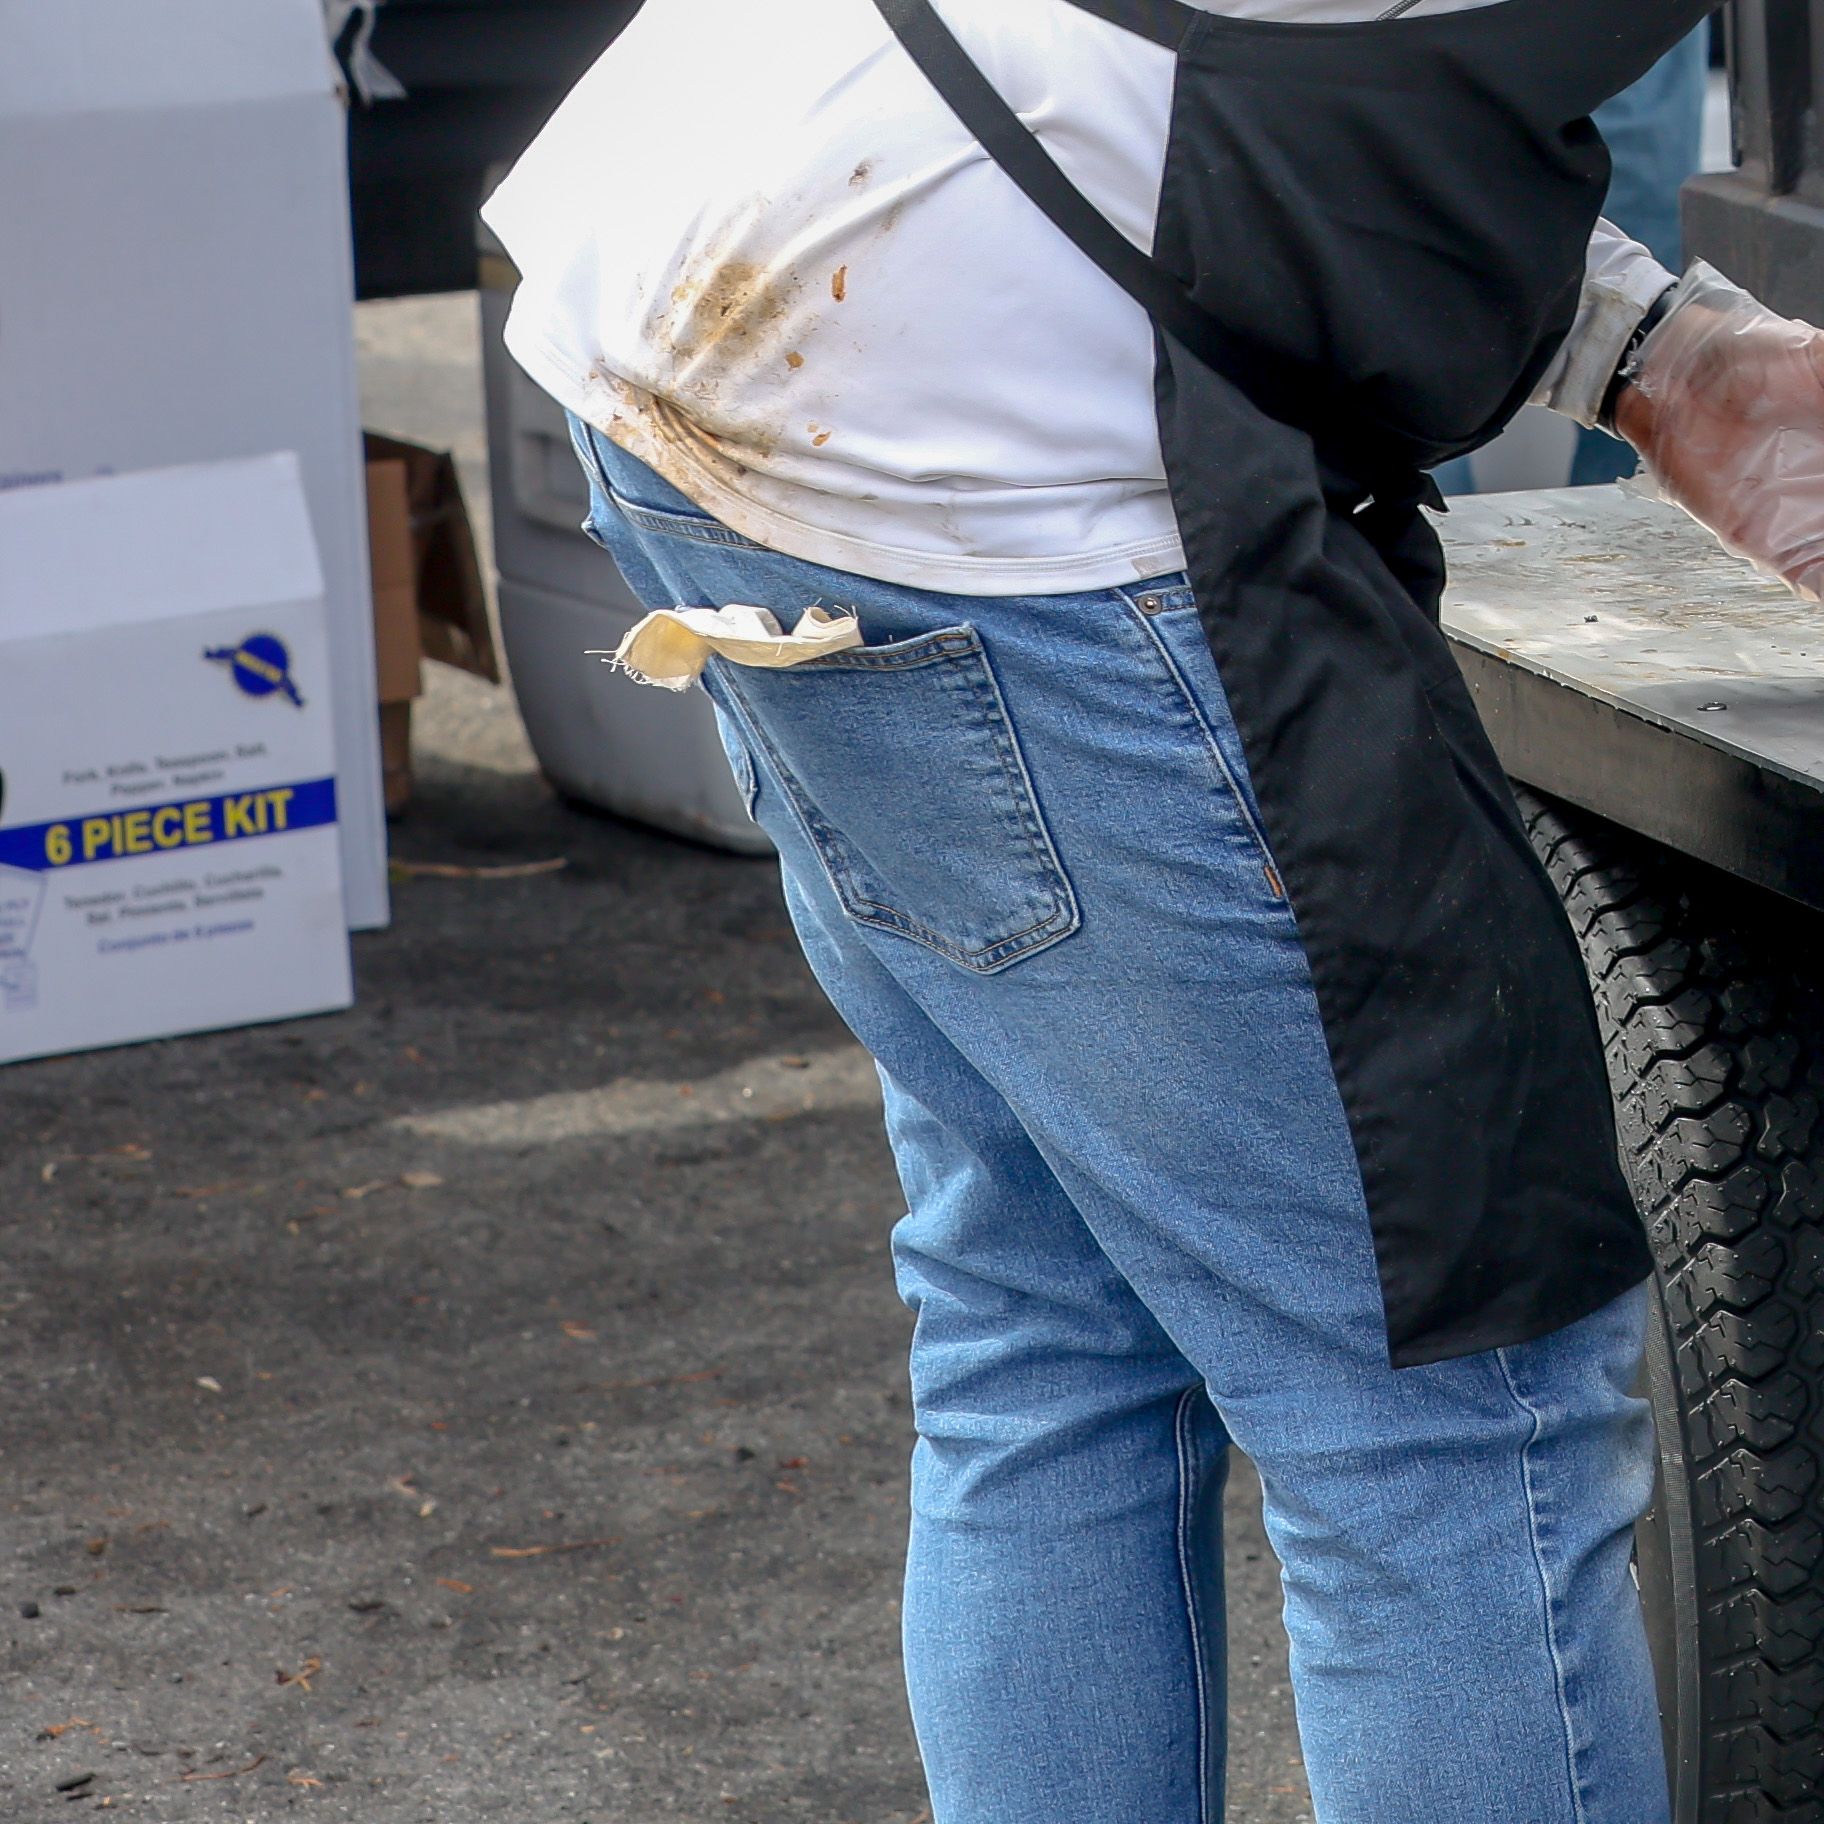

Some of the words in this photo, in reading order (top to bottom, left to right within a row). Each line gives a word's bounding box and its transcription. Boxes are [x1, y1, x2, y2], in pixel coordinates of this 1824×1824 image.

[44, 824, 73, 866] 6
[81, 800, 214, 860] PIECE
[223, 787, 294, 838] KIT
